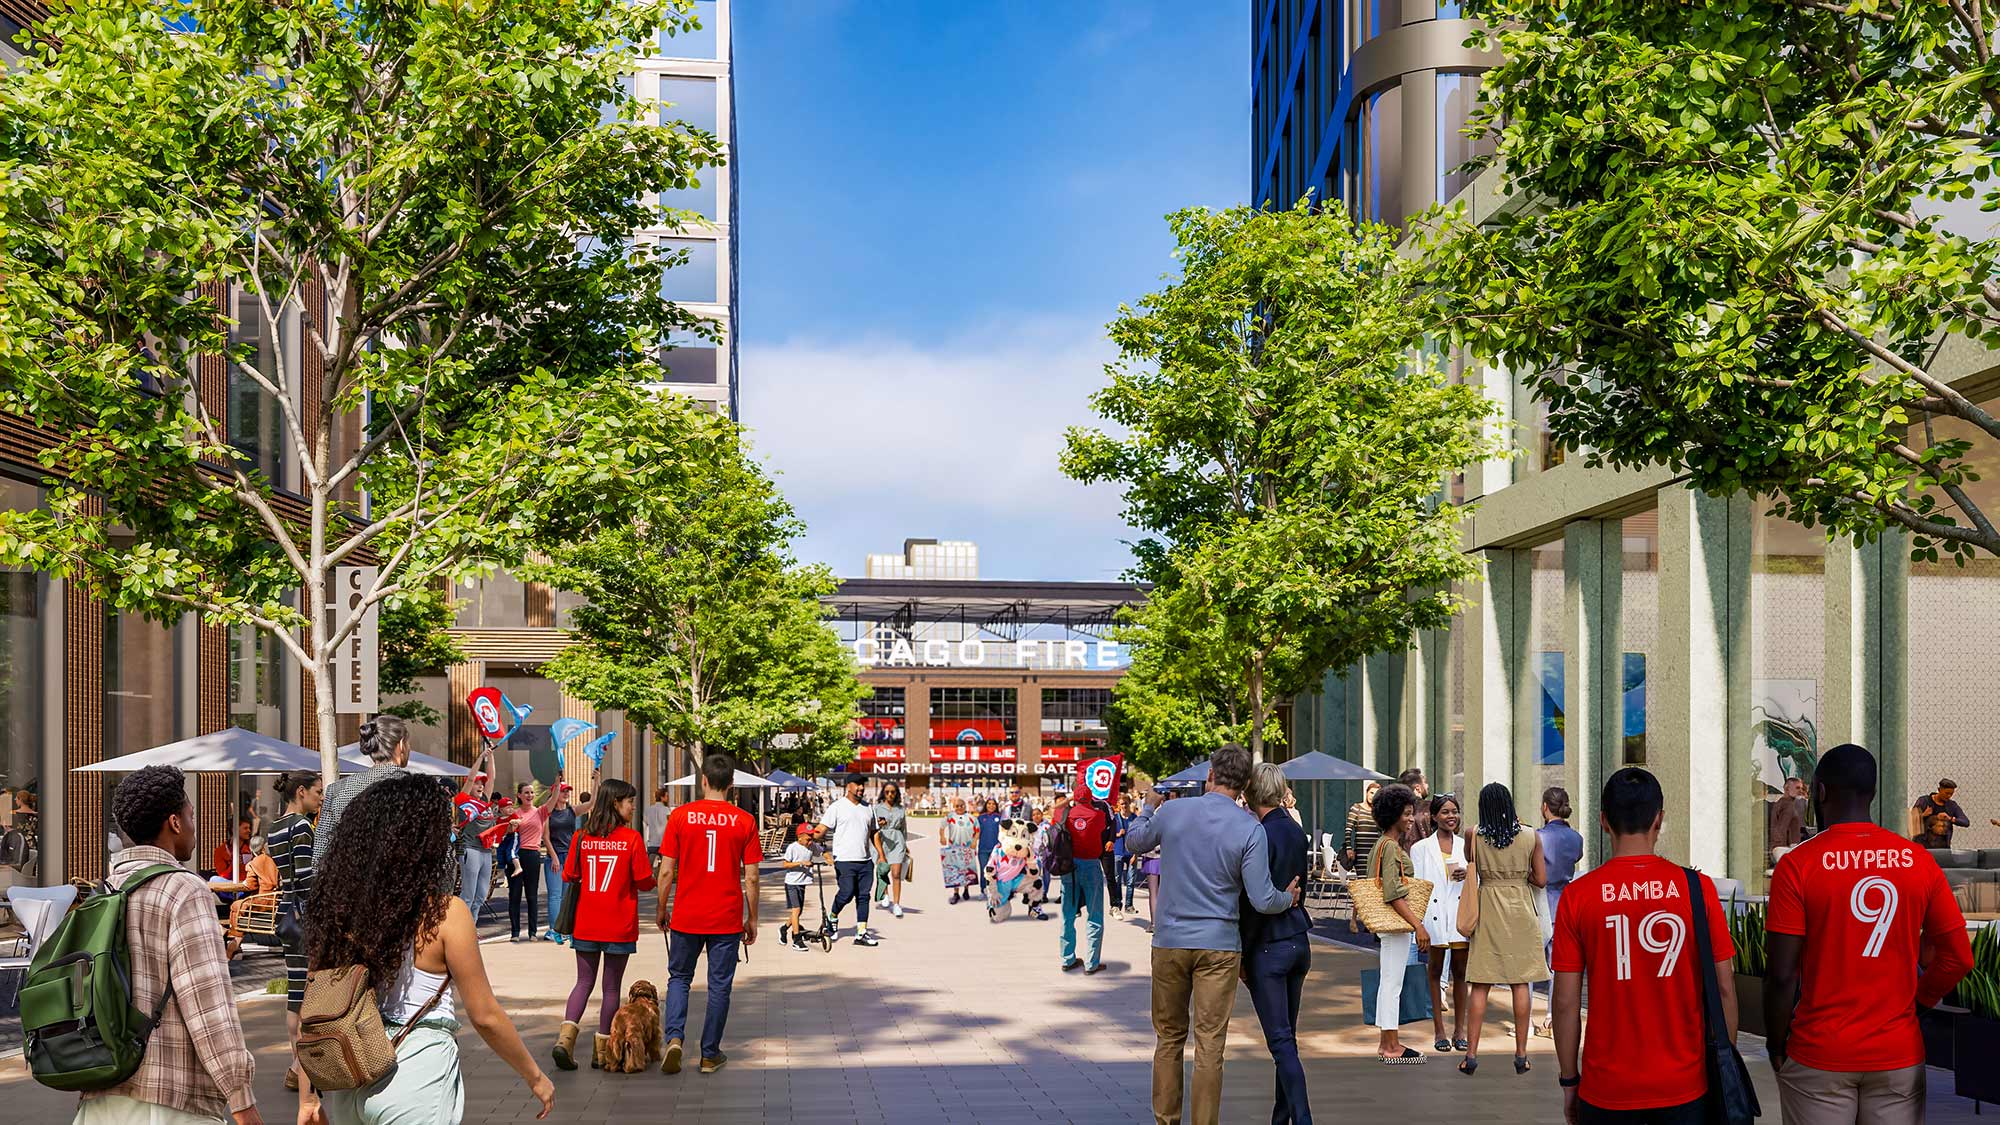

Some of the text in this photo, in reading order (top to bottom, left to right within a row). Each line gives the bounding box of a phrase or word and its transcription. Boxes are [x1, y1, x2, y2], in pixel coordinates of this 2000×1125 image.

[1017, 640, 1118, 665] FIRE
[873, 763, 1078, 774] NORTH SPONSOR GATE
[687, 811, 738, 827] BRADY
[581, 840, 628, 851] GUTIERREZ
[706, 830, 716, 872] 1
[1822, 848, 1914, 870] CUYPERS
[587, 855, 618, 892] 17
[1602, 880, 1680, 902] BAMBA
[1850, 875, 1898, 958] 9
[1605, 910, 1686, 980] 19
